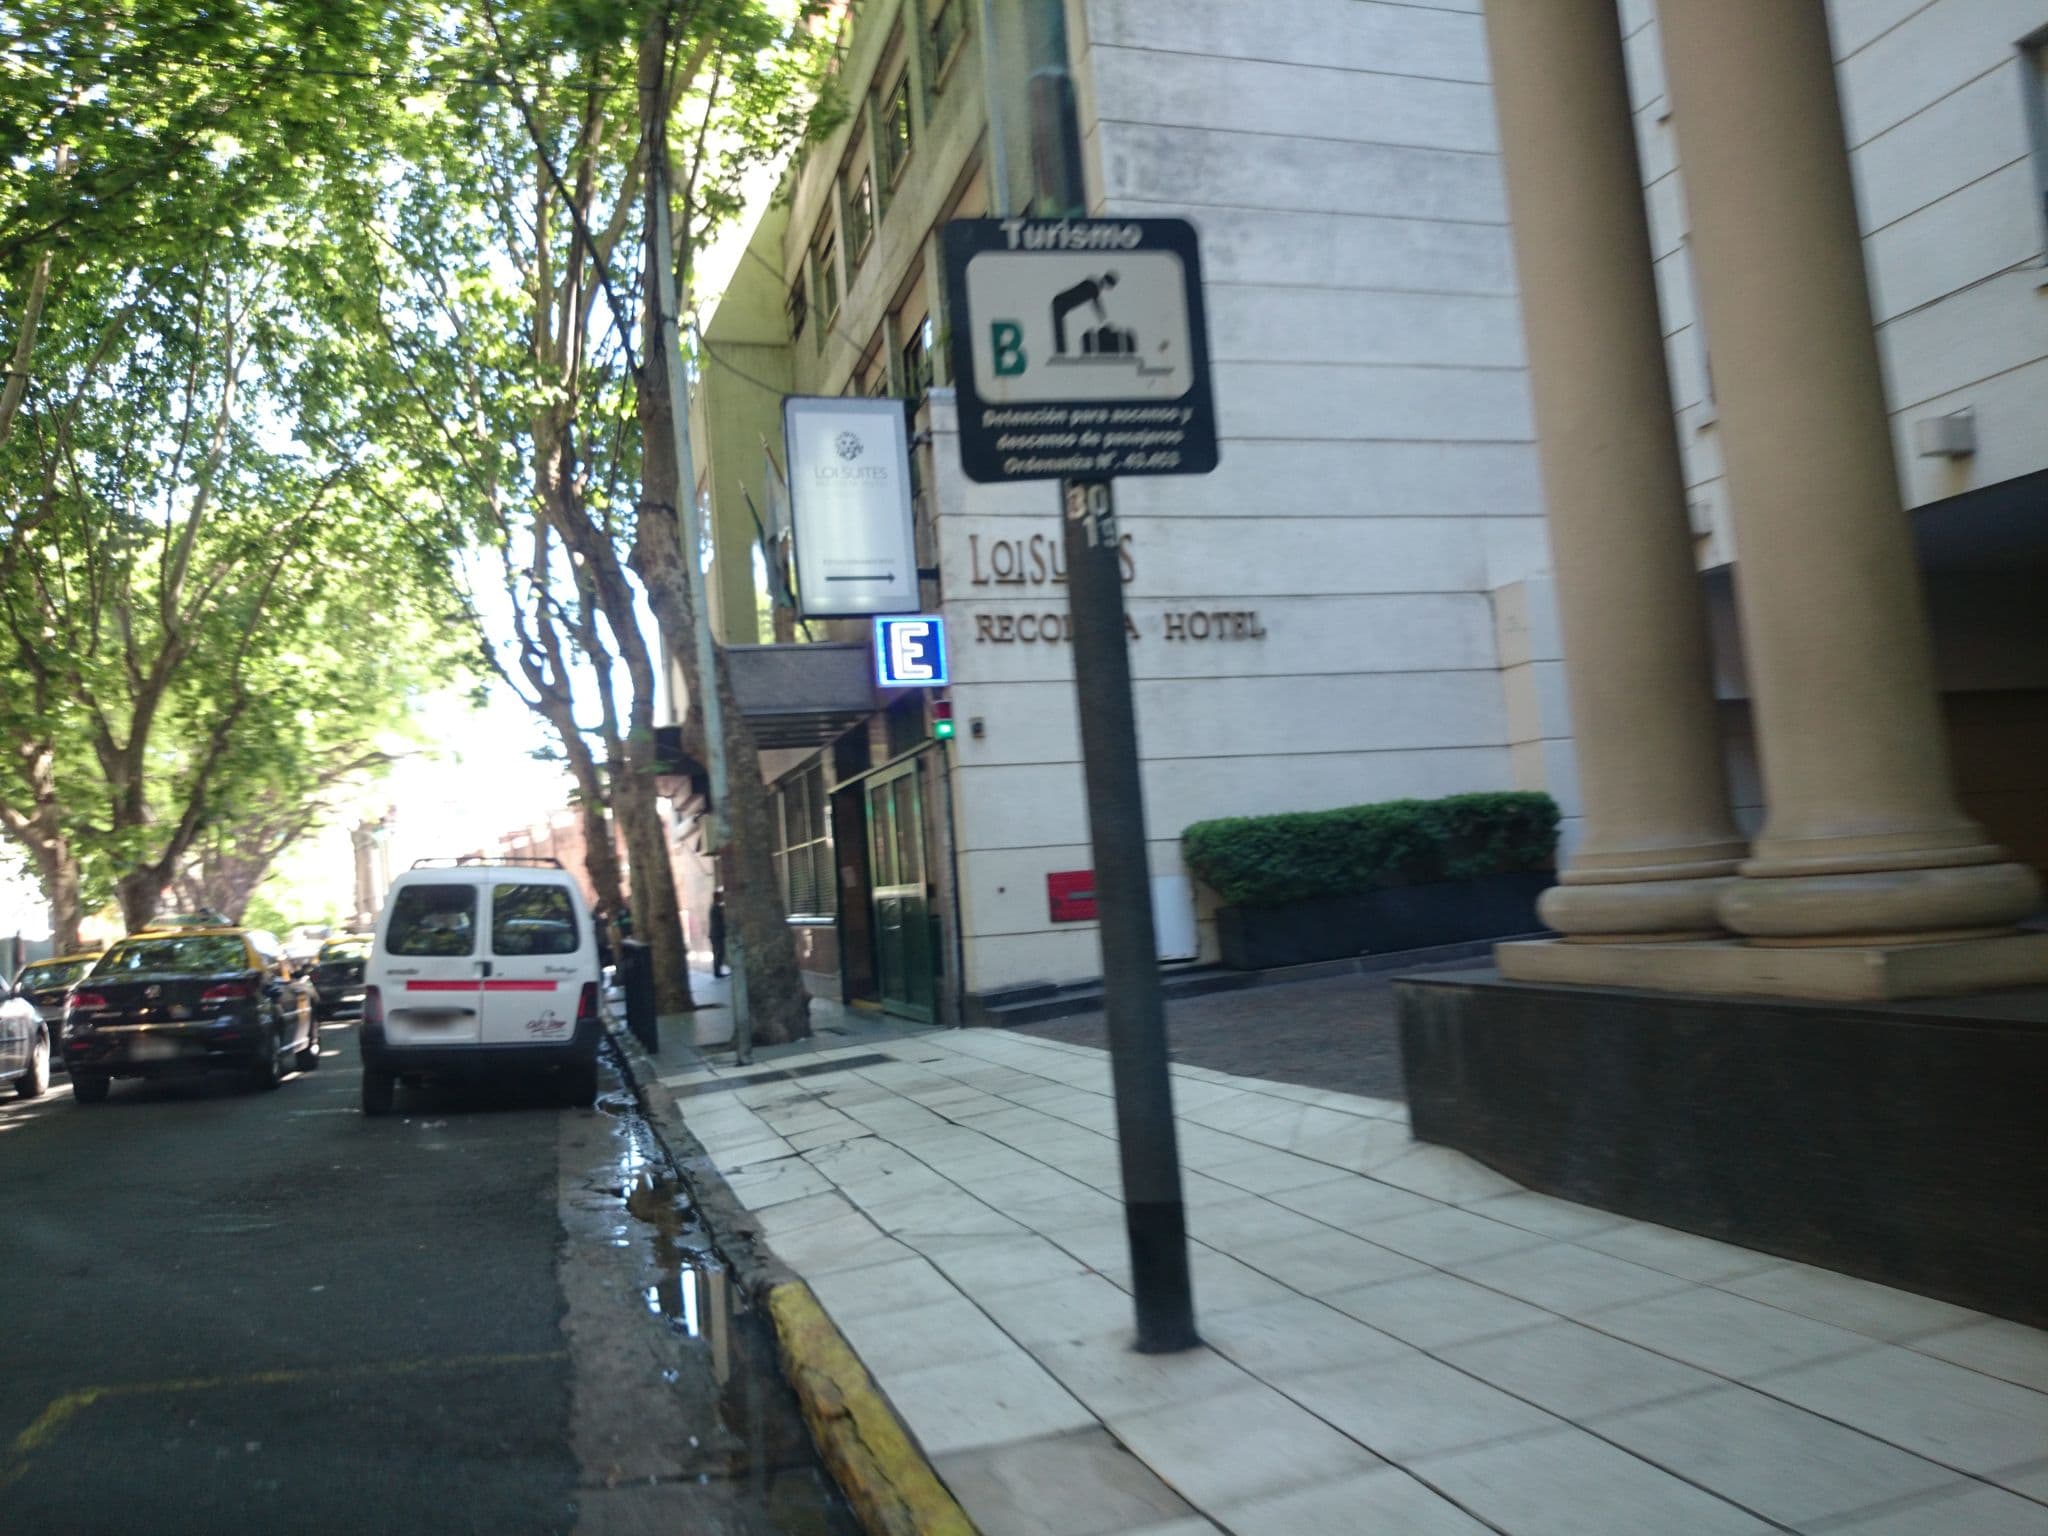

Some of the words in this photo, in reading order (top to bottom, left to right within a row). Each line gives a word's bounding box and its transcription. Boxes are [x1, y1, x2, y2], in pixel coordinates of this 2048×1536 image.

[1001, 218, 1143, 249] Turismo
[990, 318, 1028, 377] B
[1070, 408, 1109, 426] para
[1180, 407, 1194, 426] y
[996, 432, 1077, 450] descenso
[1078, 429, 1103, 447] de
[1164, 611, 1266, 640] HOTEL
[890, 621, 933, 680] E
